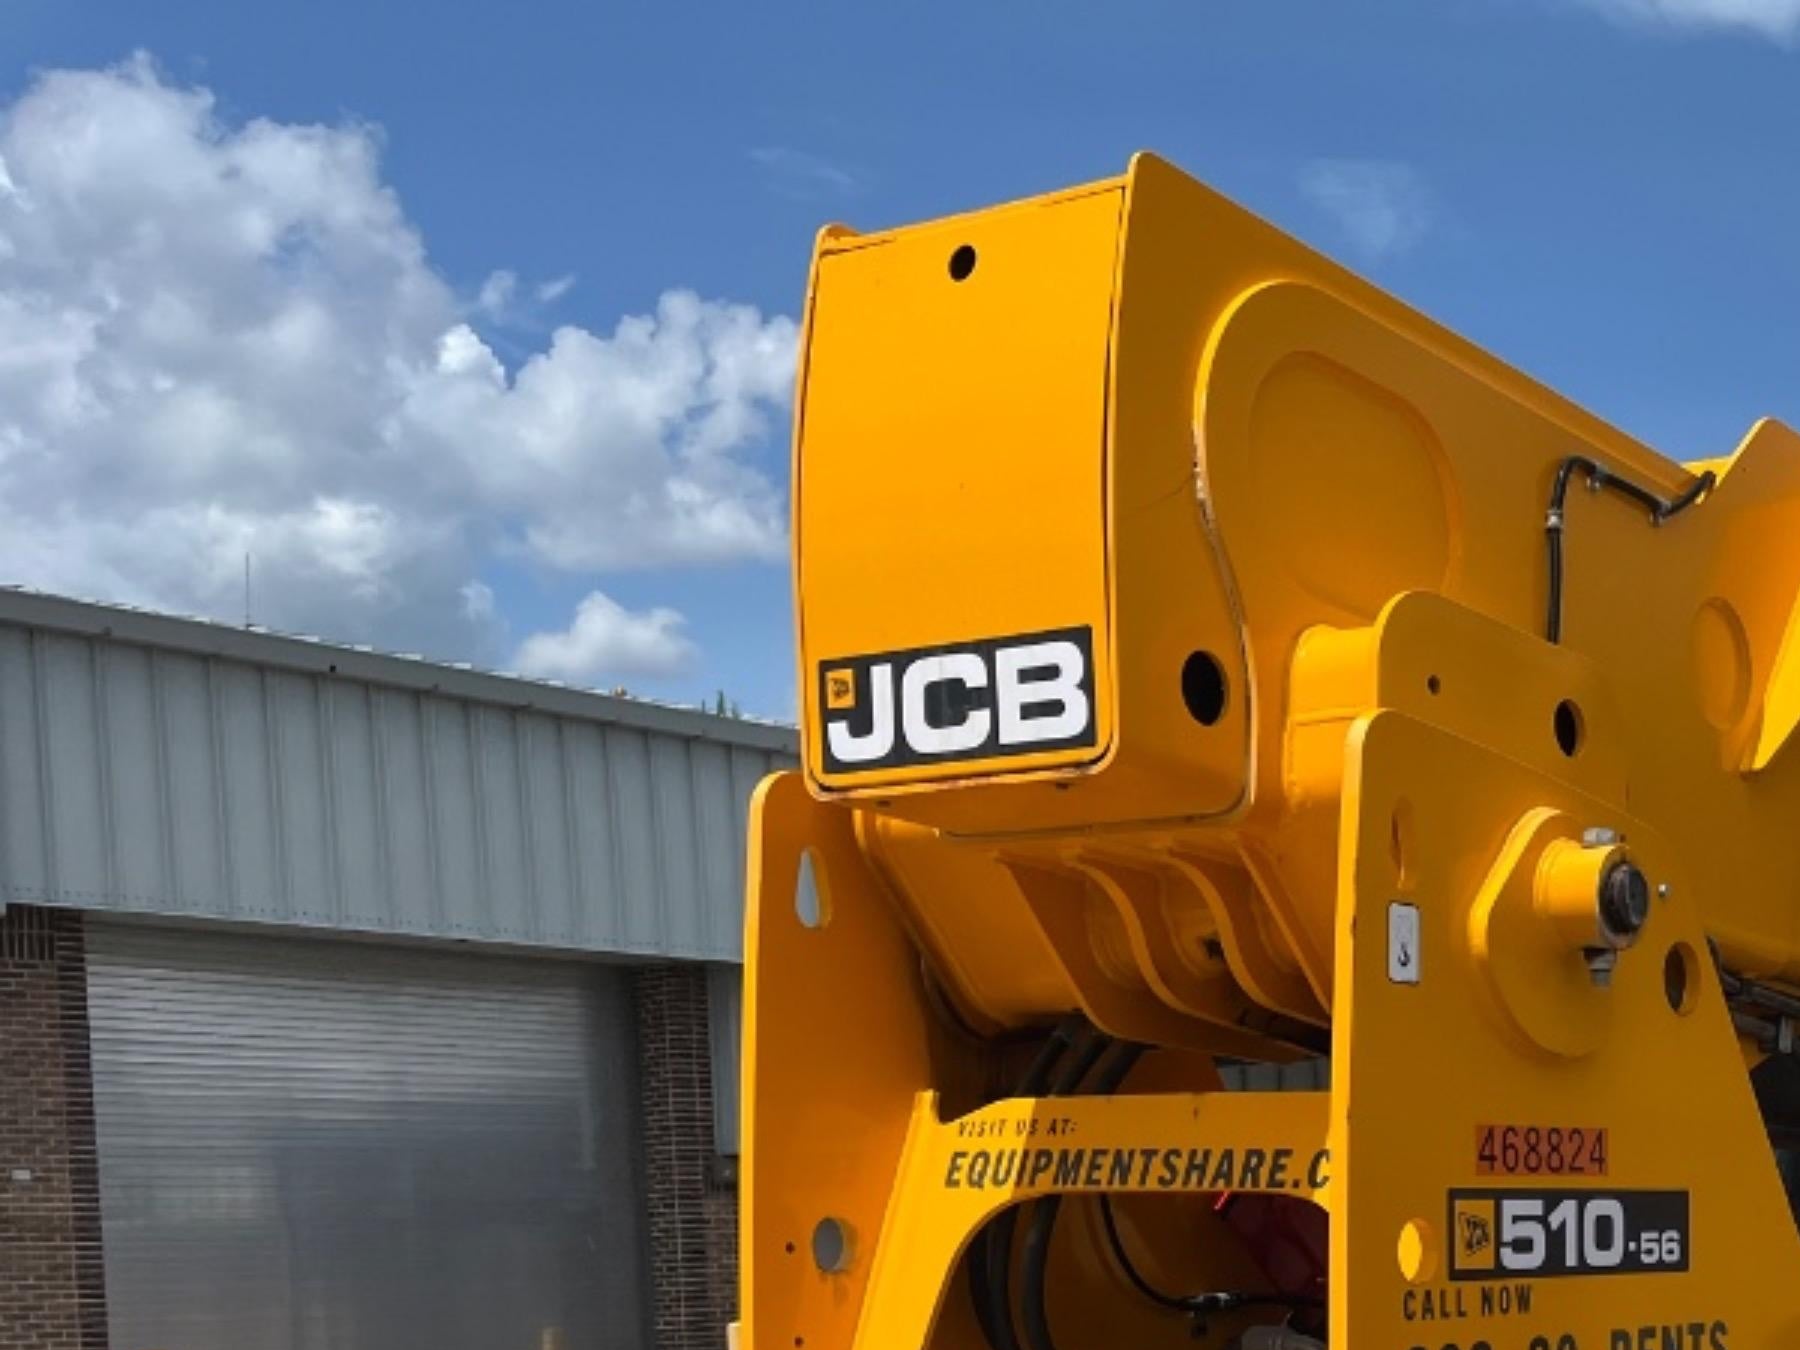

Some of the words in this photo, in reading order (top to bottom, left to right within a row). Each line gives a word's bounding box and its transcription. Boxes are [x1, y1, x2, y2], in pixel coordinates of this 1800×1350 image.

[827, 641, 1090, 763] JCB
[959, 1118, 1008, 1138] VISIT
[1016, 1118, 1039, 1136] US
[1477, 1125, 1607, 1174] 468824
[1403, 1288, 1468, 1321] CALL
[1481, 1284, 1532, 1316] NOW
